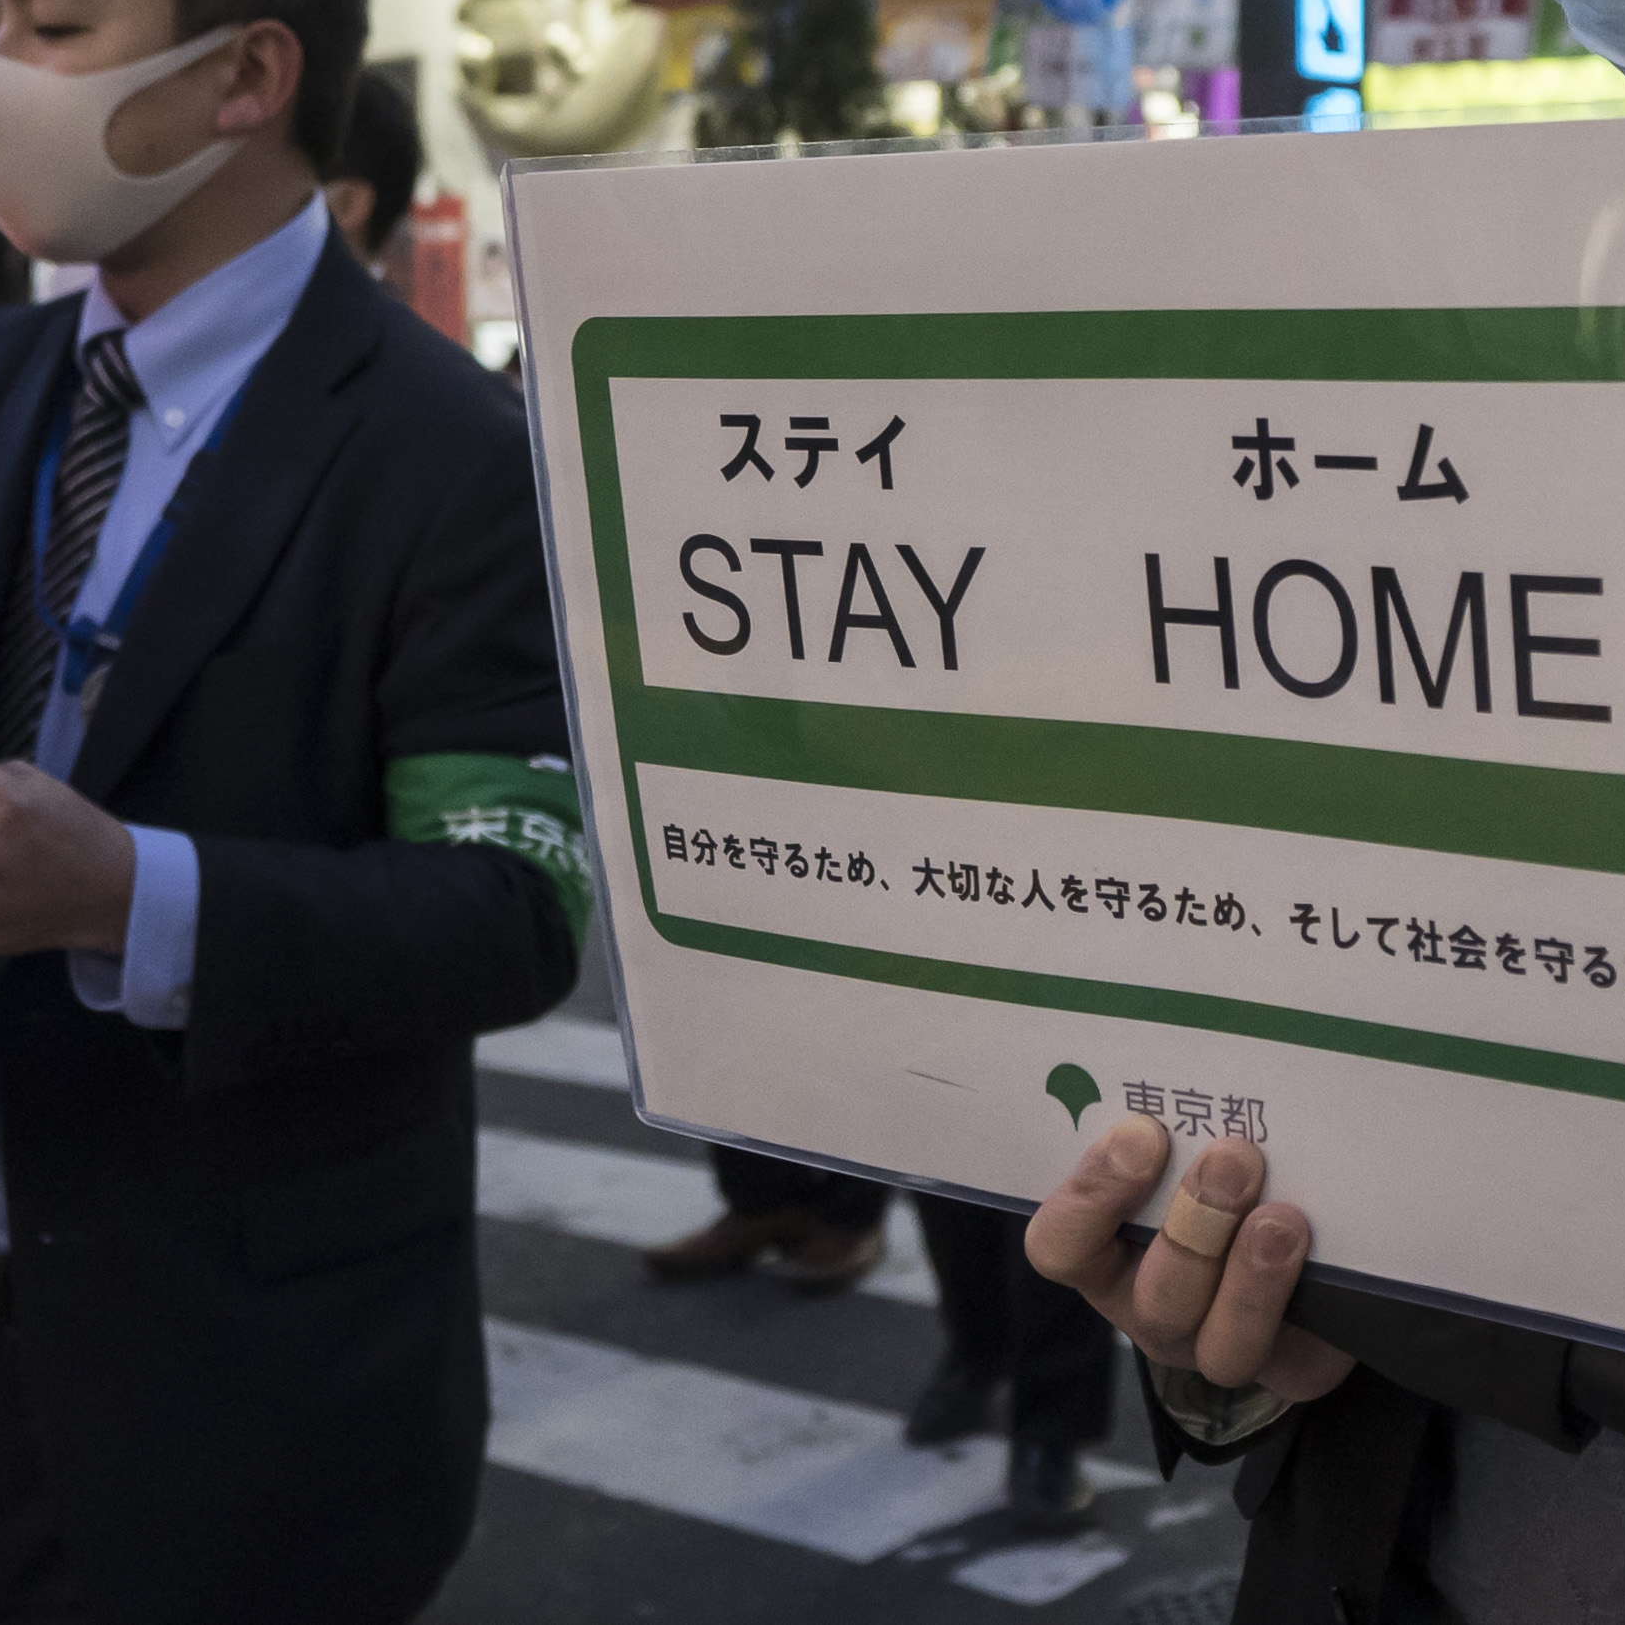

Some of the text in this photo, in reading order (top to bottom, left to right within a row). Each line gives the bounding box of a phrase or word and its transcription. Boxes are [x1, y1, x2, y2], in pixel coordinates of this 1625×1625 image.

[717, 413, 1471, 506] ステイ ホーム
[678, 532, 1614, 724] STAY HOME
[1122, 1080, 1269, 1144] 東京都
